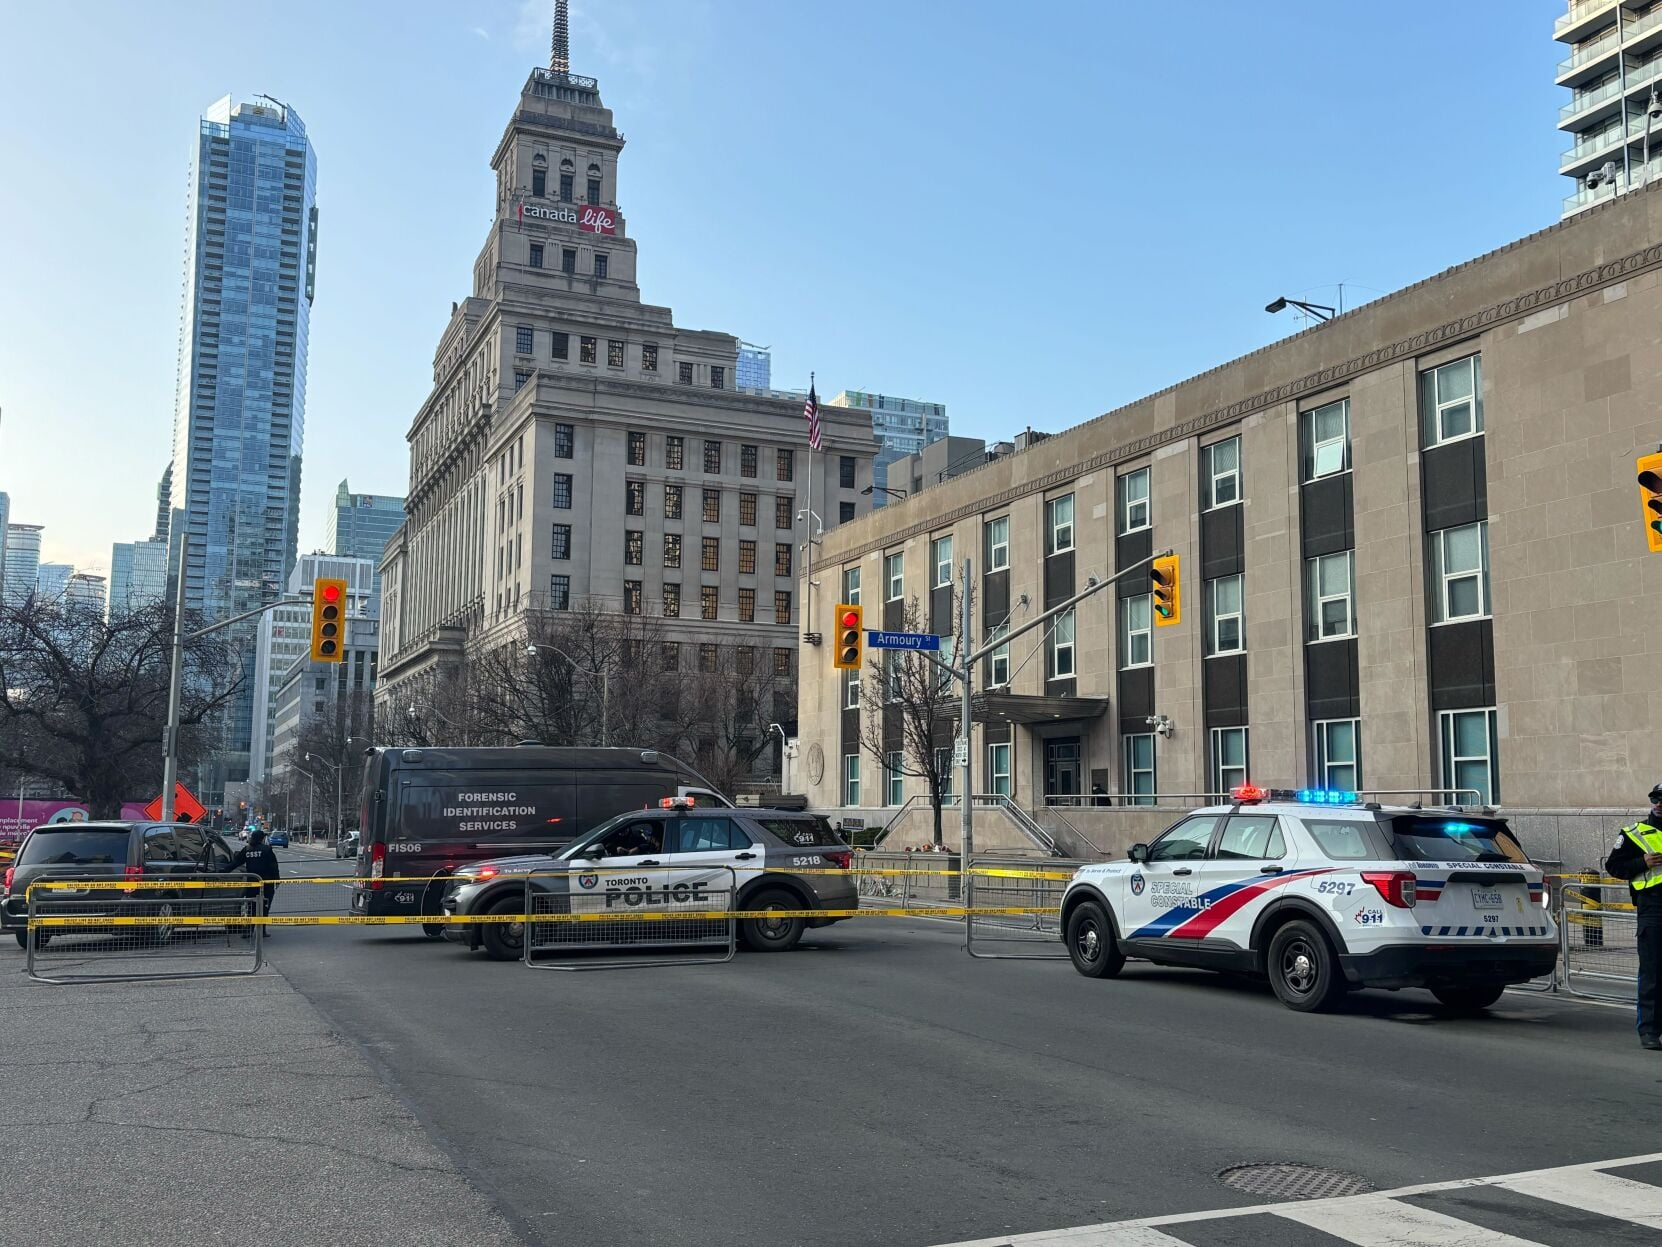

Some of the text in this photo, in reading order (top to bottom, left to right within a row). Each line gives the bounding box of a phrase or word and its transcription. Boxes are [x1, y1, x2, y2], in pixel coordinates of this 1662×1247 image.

[523, 205, 615, 234] canada life
[877, 633, 922, 648] Armoury
[458, 793, 517, 802] FORENSIC
[443, 806, 536, 817] IDENTIFICATION
[459, 821, 517, 831] SERVICES
[388, 843, 421, 853] FIS06
[793, 855, 821, 866] 5218
[1483, 863, 1526, 871] CONSTABLE
[605, 877, 648, 887] TORONTO
[1151, 881, 1193, 895] SPECIAL
[1317, 881, 1356, 896] 5297
[605, 881, 708, 908] POLICE
[1151, 895, 1212, 911] CONSTABLE
[1483, 915, 1499, 923] 5297
